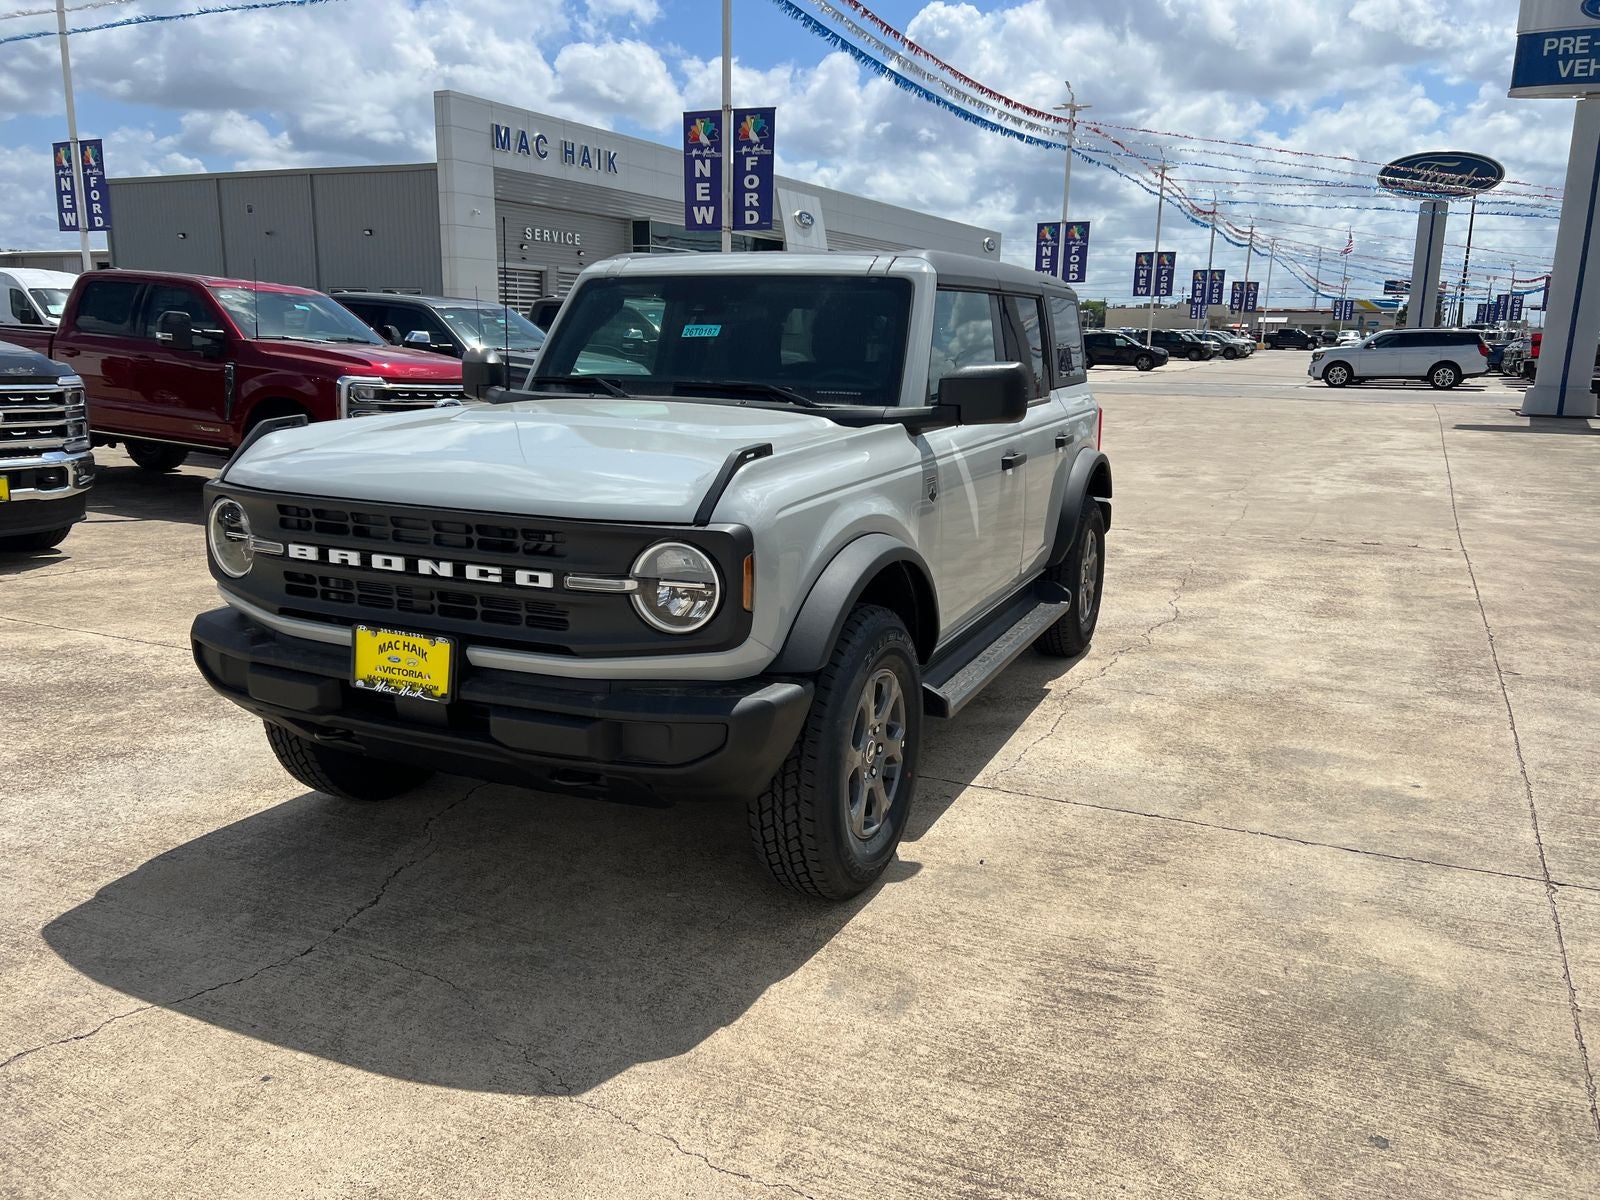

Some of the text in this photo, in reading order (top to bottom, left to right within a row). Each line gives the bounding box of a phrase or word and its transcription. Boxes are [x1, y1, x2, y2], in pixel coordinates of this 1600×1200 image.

[493, 124, 618, 174] MAC HAIK
[61, 177, 76, 226] NEW
[90, 177, 104, 227] FORD
[692, 159, 715, 225] NEW
[743, 156, 760, 225] FORD
[525, 227, 581, 245] SERVICE
[1068, 246, 1080, 281] FORD
[1137, 270, 1147, 295] NEW
[1160, 270, 1169, 295] FORD
[1194, 283, 1203, 303] NEW
[1212, 283, 1220, 304] FORD
[288, 543, 554, 588] BRONCO
[378, 640, 428, 662] MAC HAIK
[382, 665, 424, 680] VICTORIA
[374, 680, 424, 698] Mac Haik
